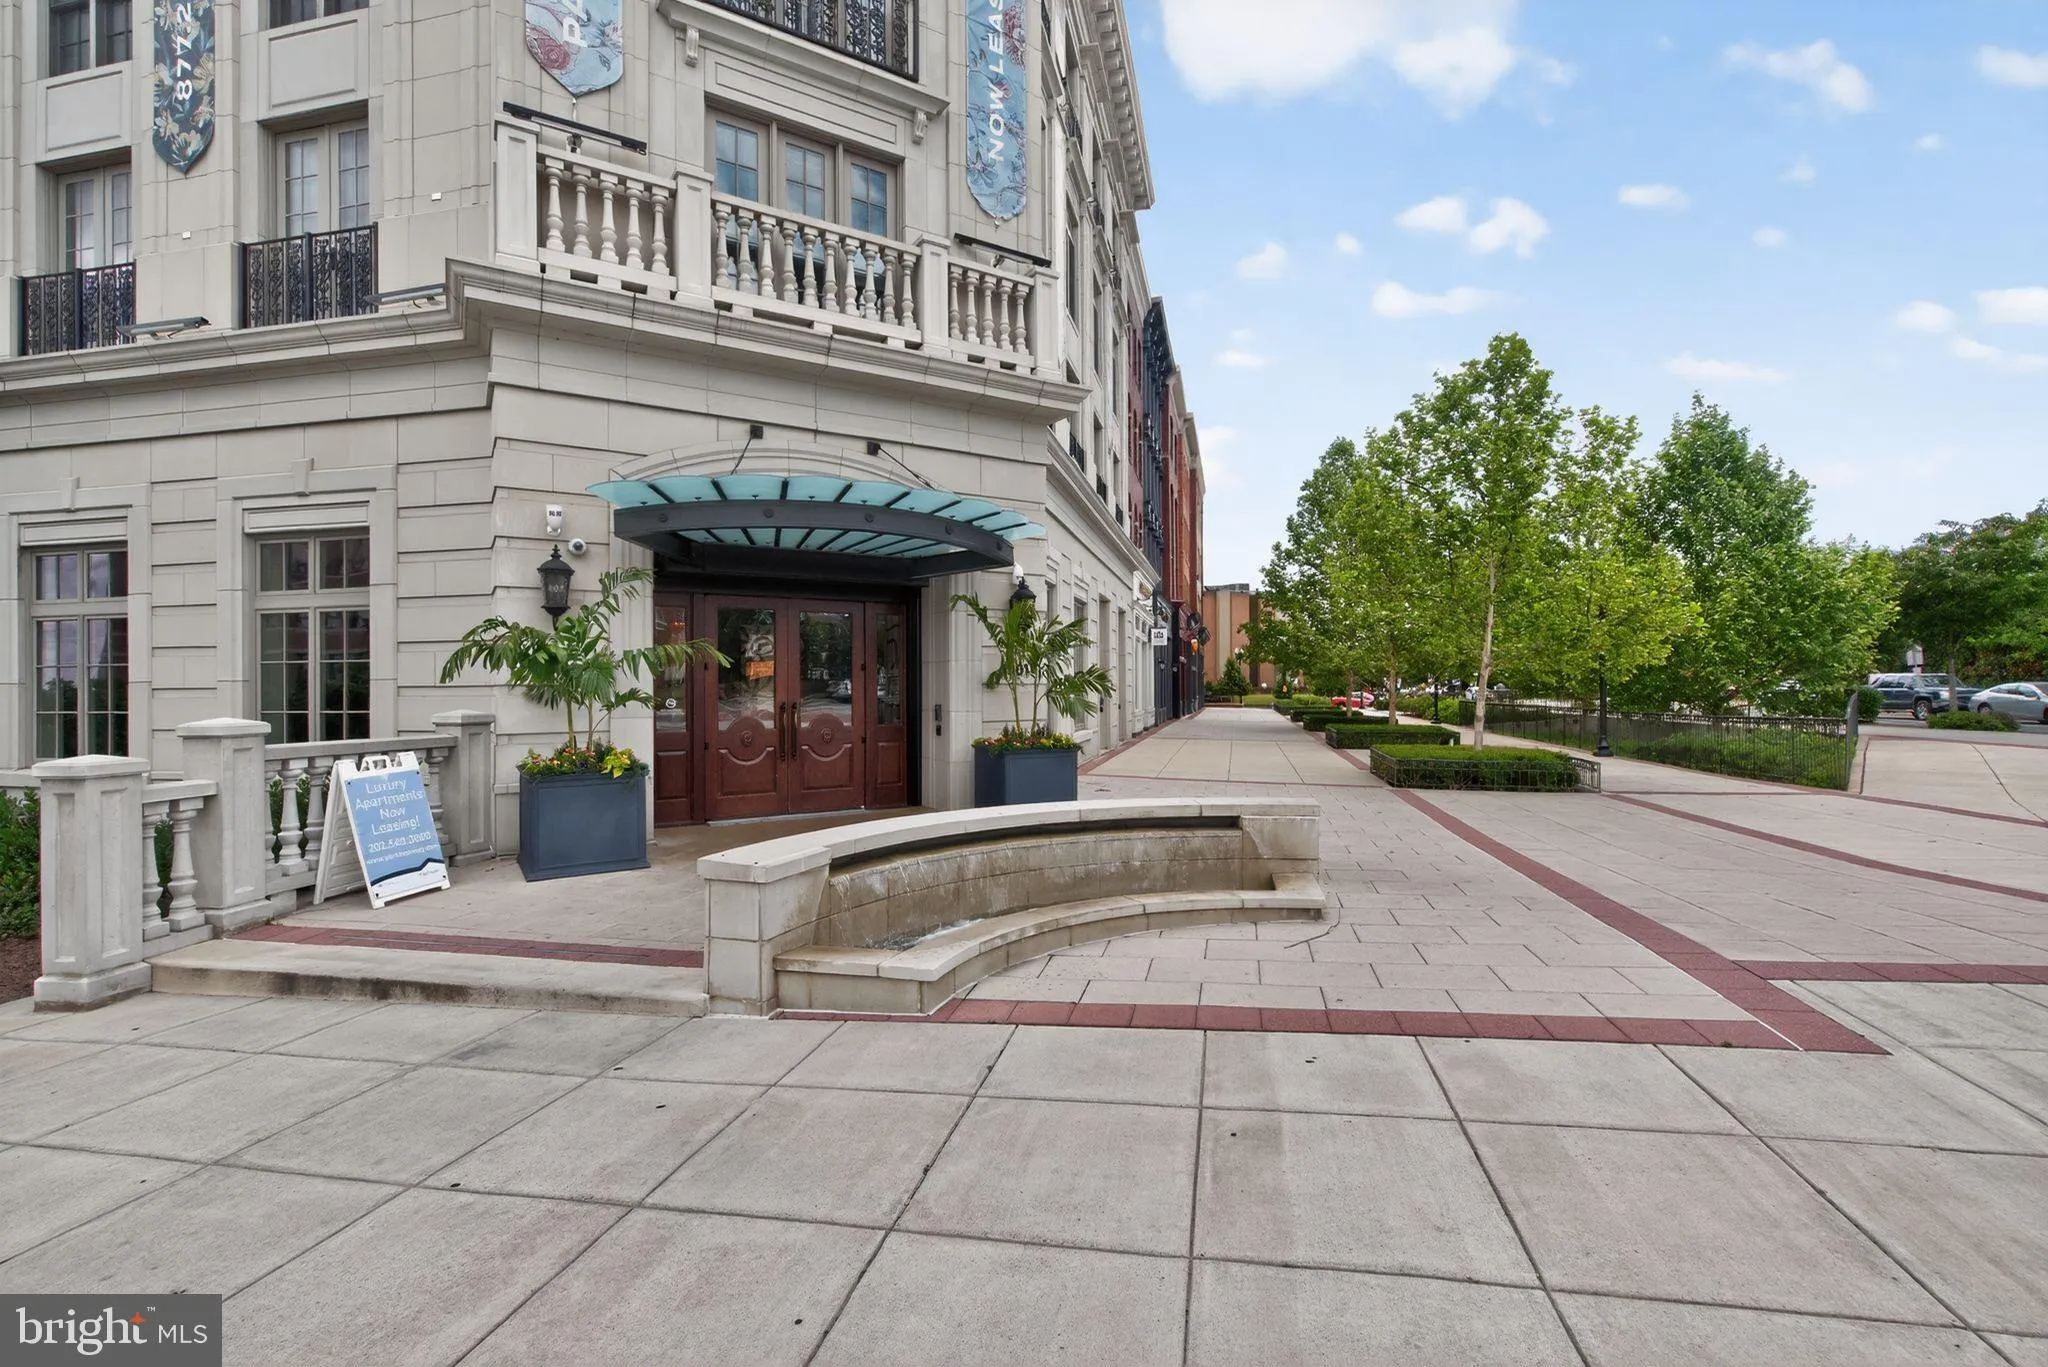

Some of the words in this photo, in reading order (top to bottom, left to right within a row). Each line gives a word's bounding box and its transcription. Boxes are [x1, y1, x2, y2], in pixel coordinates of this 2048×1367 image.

[988, 81, 1005, 162] NOW
[365, 779, 406, 794] Luxury
[355, 790, 424, 811] Apartments
[379, 807, 406, 820] Now
